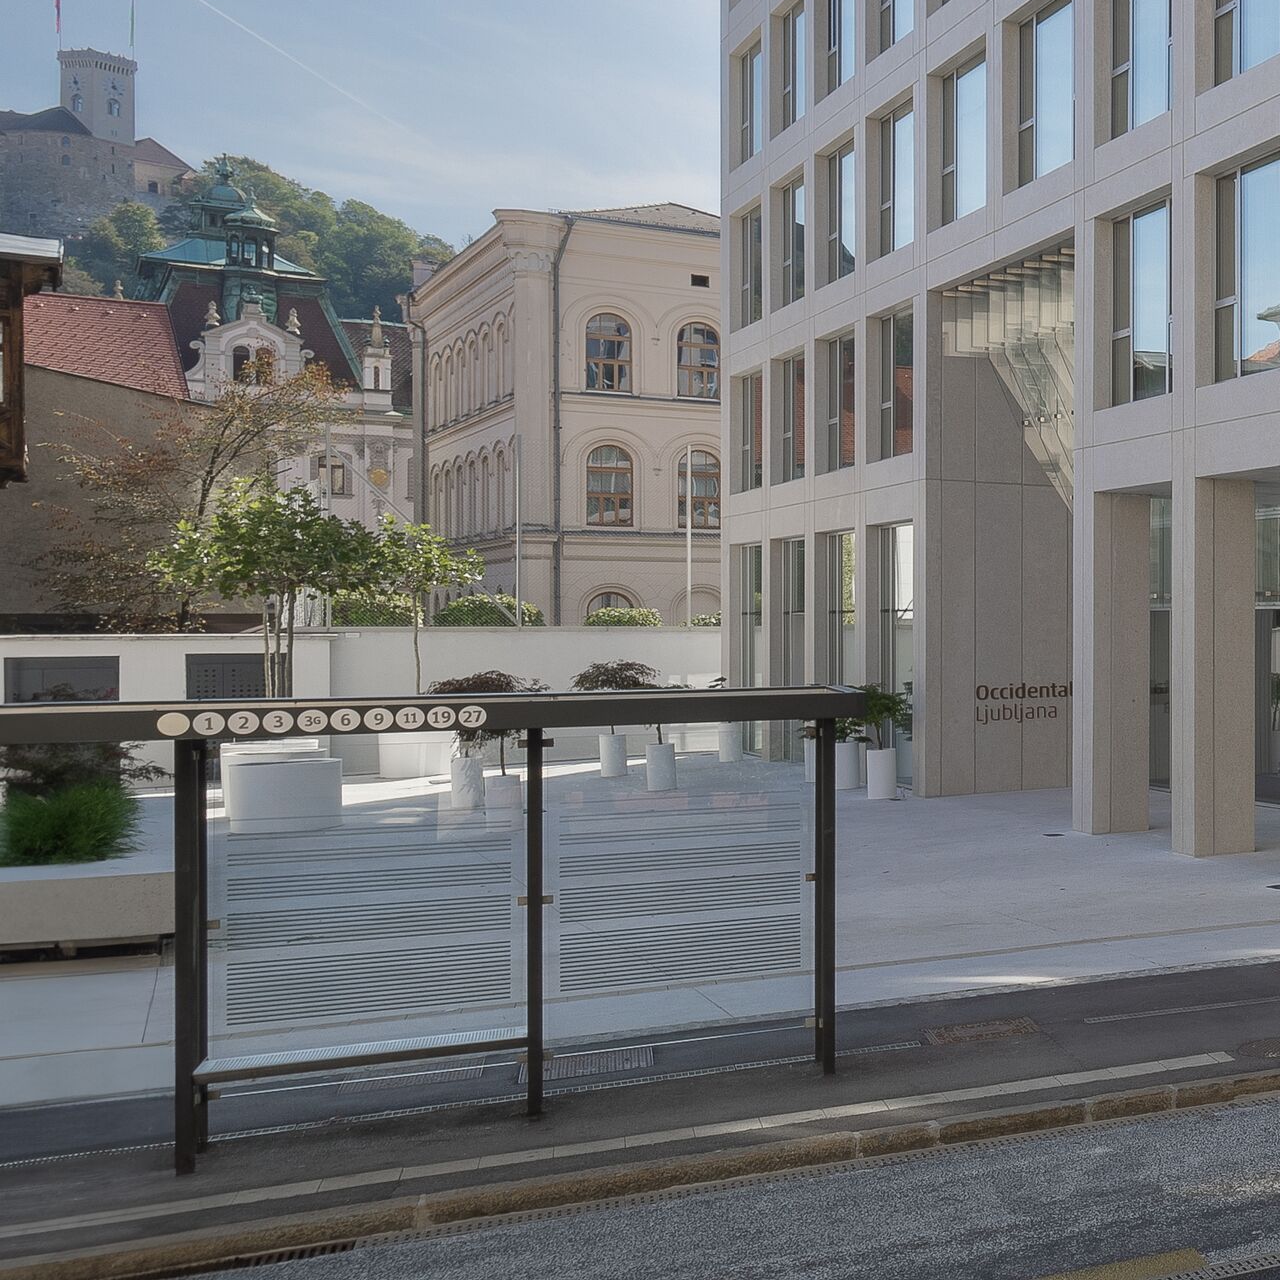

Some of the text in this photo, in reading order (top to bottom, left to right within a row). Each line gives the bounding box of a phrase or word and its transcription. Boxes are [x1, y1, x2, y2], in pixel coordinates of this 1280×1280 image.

[976, 681, 1073, 701] Occidental
[204, 710, 483, 730] 1 2 3 3G 6 9 11 19 27
[976, 704, 1058, 725] Ljubljana
